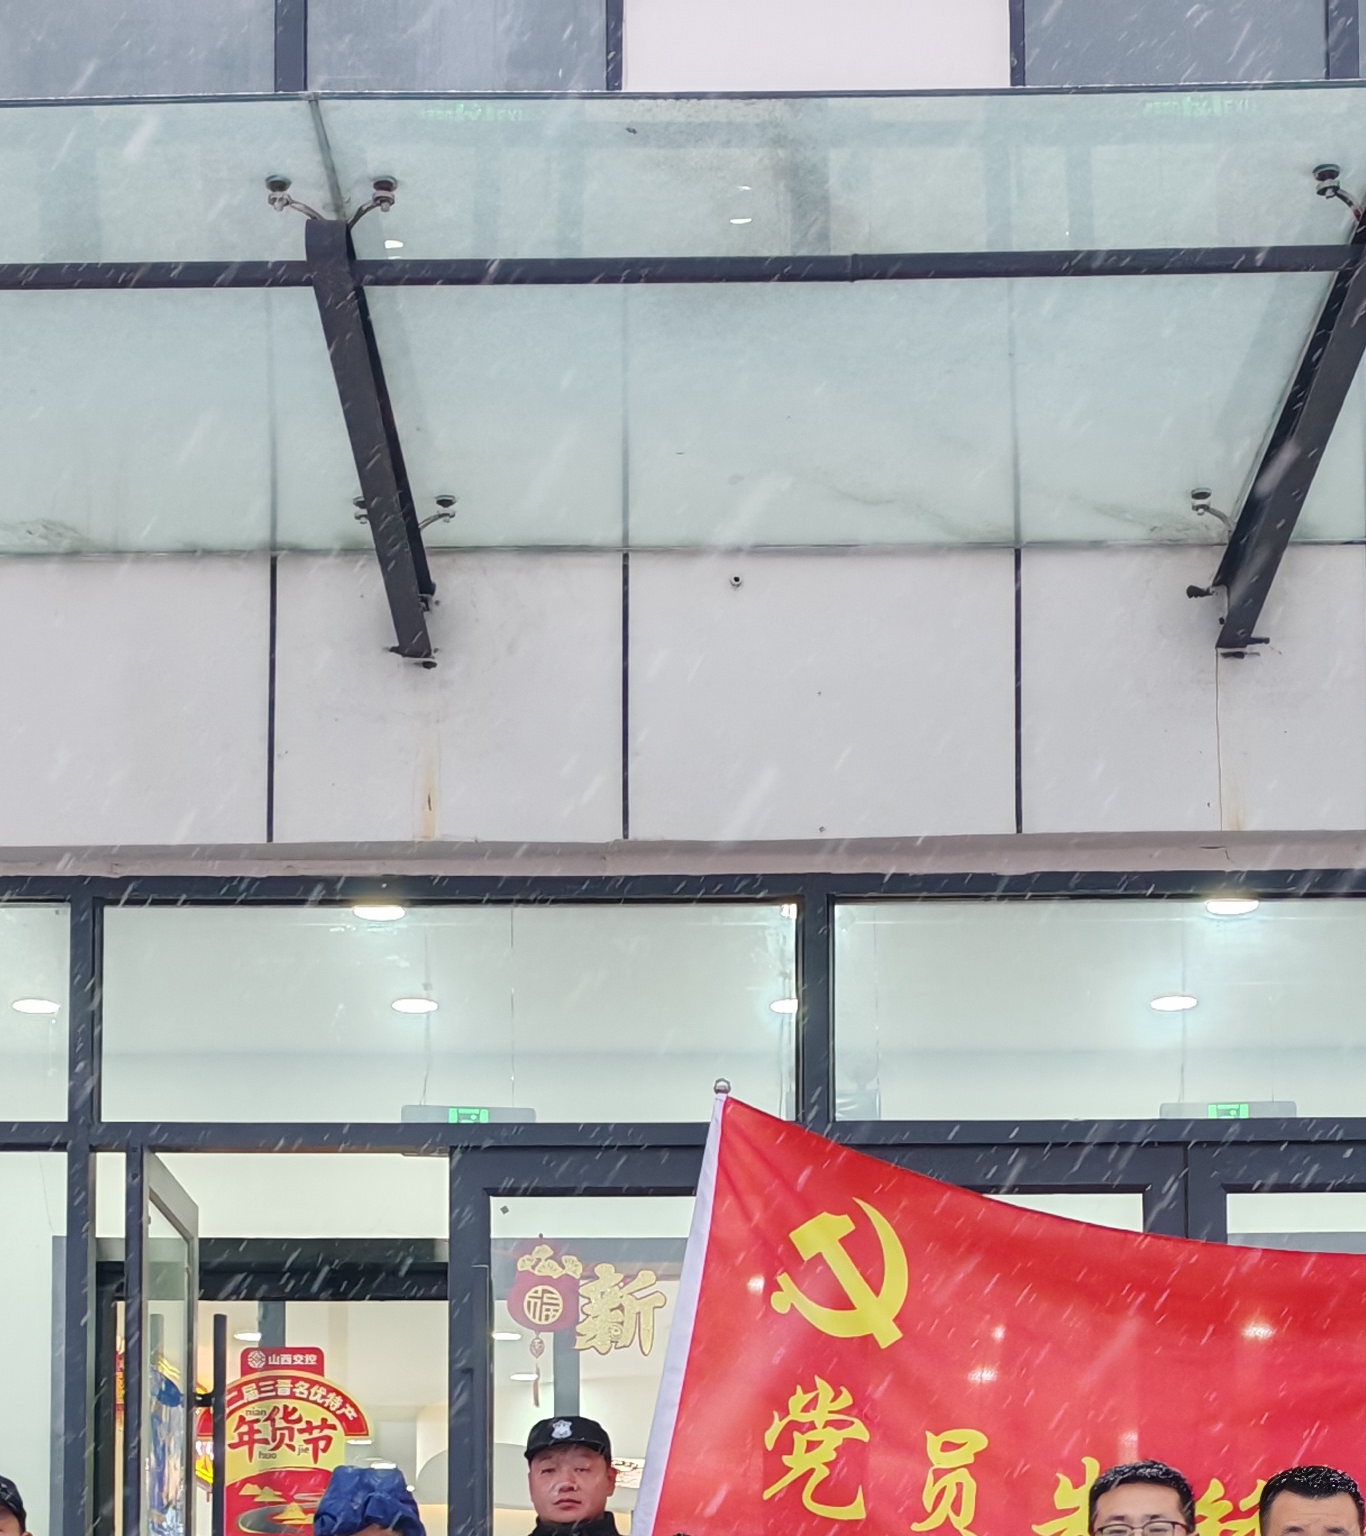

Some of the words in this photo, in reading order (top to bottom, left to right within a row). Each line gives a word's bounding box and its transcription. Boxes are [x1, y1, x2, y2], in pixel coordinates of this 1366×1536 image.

[267, 1353, 318, 1366] 山西交控
[245, 1406, 267, 1417] nian
[227, 1404, 338, 1465] 年货节
